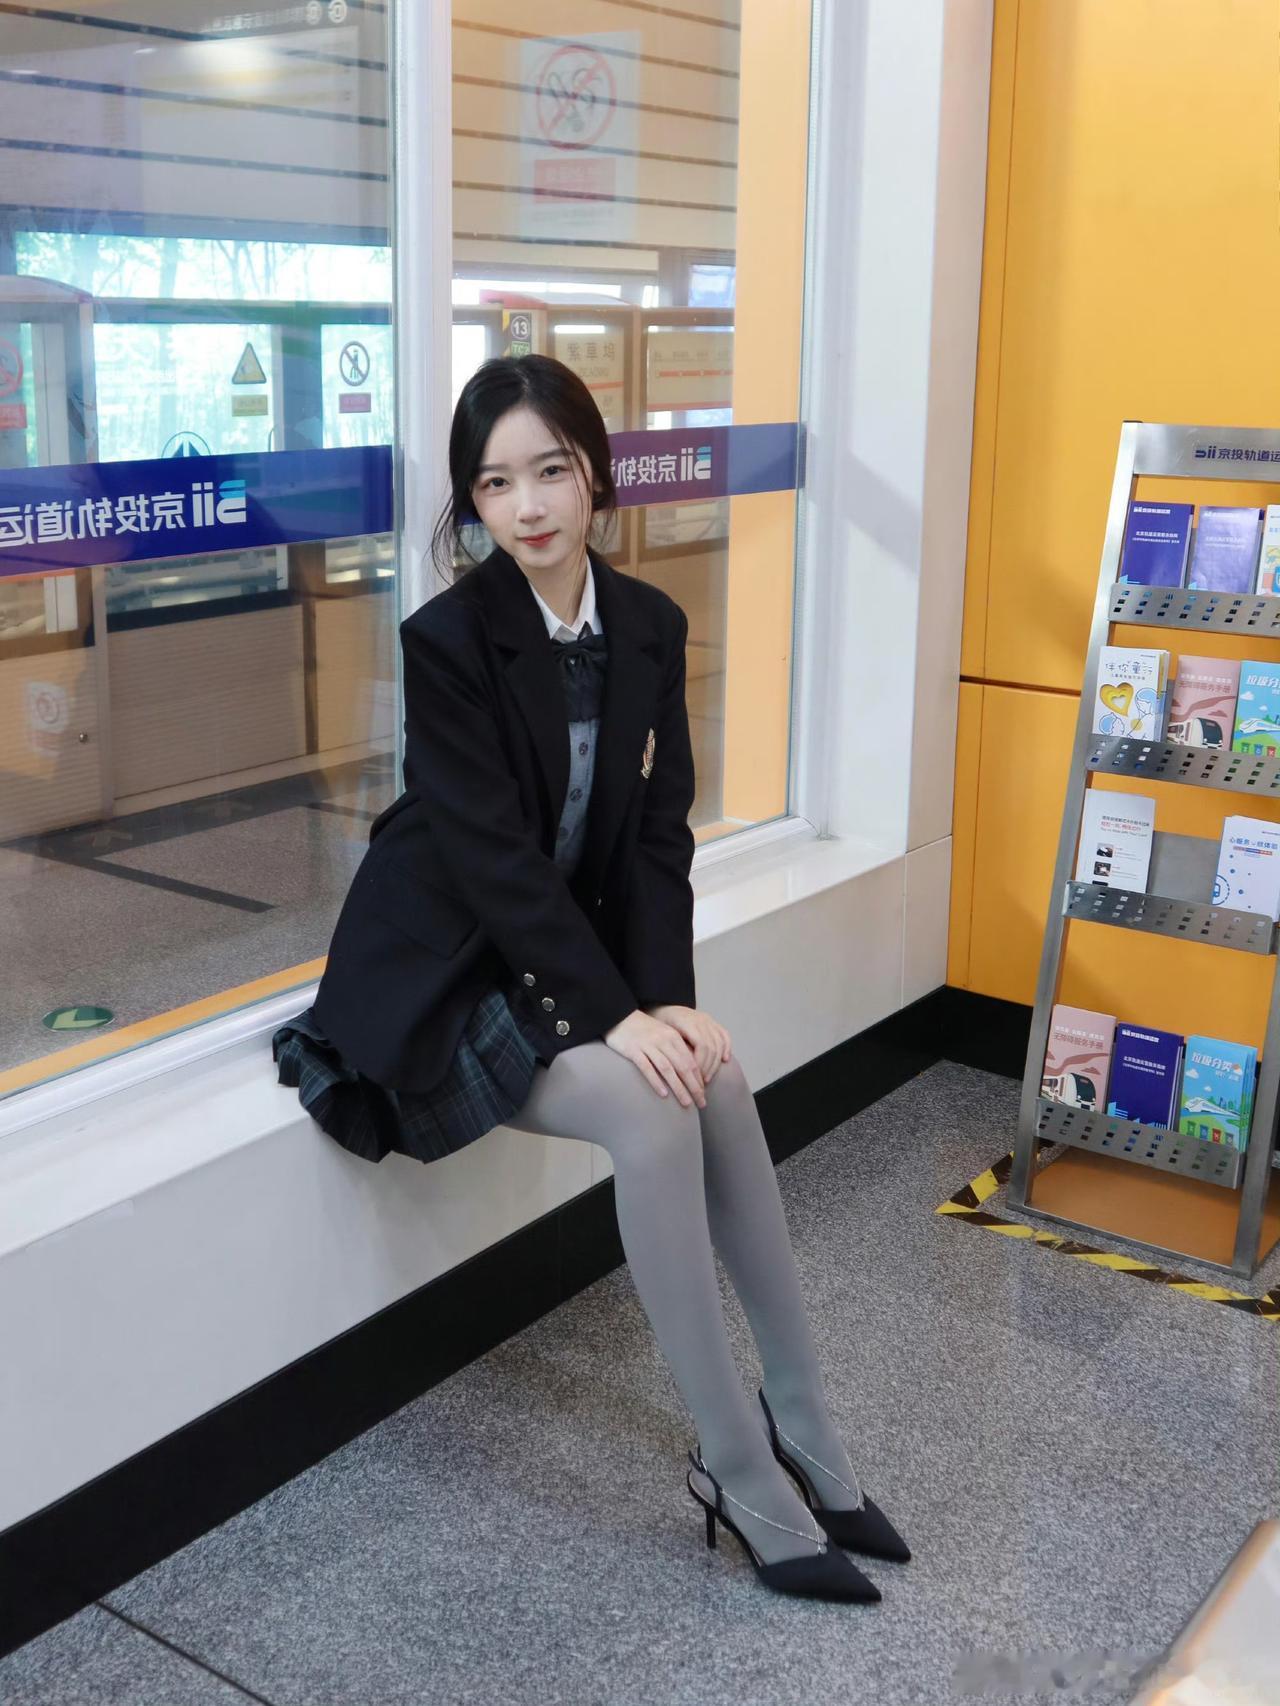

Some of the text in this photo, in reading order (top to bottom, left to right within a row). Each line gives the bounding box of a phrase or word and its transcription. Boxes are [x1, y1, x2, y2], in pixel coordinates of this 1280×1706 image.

[513, 321, 528, 335] 13
[1246, 674, 1280, 689] 垃圾分
